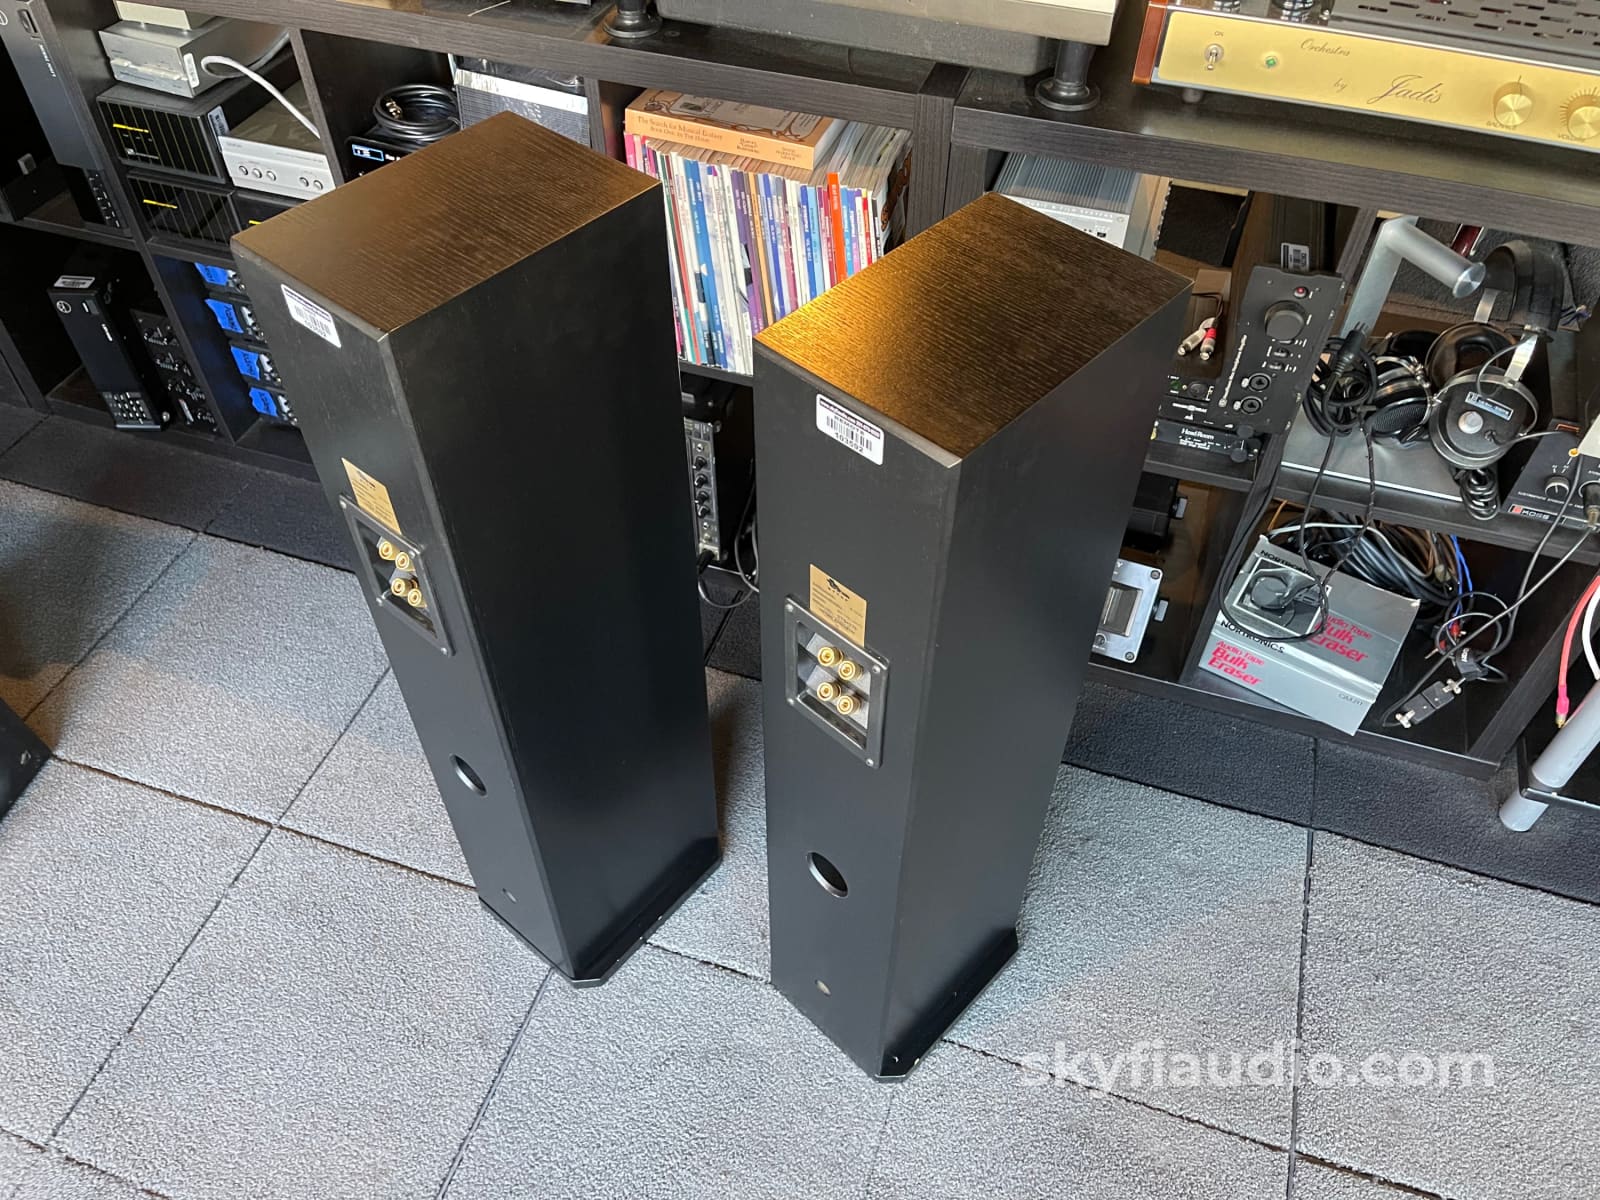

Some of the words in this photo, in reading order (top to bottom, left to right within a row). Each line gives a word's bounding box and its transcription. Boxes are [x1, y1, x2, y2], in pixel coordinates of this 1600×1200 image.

[1300, 37, 1351, 57] Orchestra
[1333, 77, 1348, 94] by
[1367, 74, 1443, 105] Jadis
[1350, 623, 1373, 640] Tape
[1211, 646, 1249, 670] Bulk
[1216, 640, 1243, 656] Audio
[1243, 650, 1265, 666] Tape
[1207, 657, 1262, 686] Eraser
